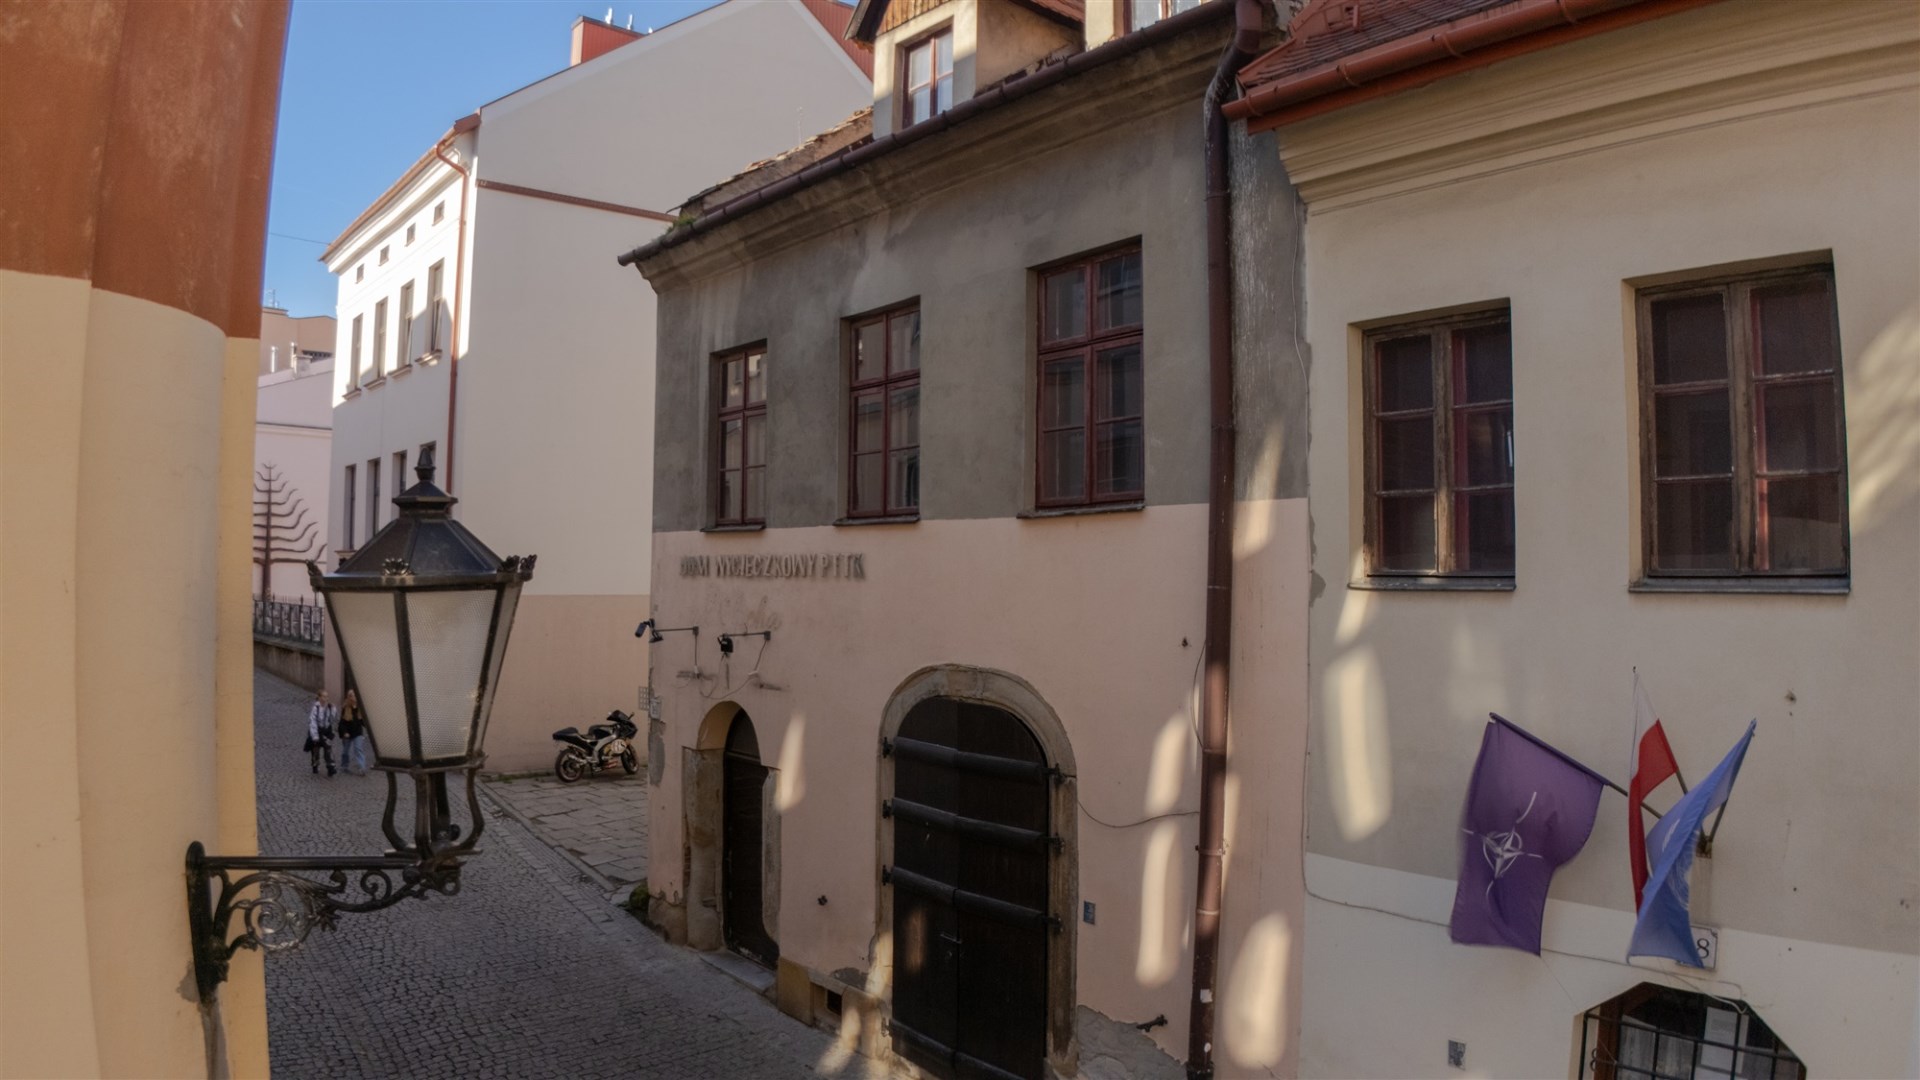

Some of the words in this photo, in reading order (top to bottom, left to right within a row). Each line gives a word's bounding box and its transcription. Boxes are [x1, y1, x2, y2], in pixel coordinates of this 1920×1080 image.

[716, 552, 817, 579] WYCIECZKOWY
[819, 552, 866, 580] PTTK
[1696, 938, 1710, 959] 8
